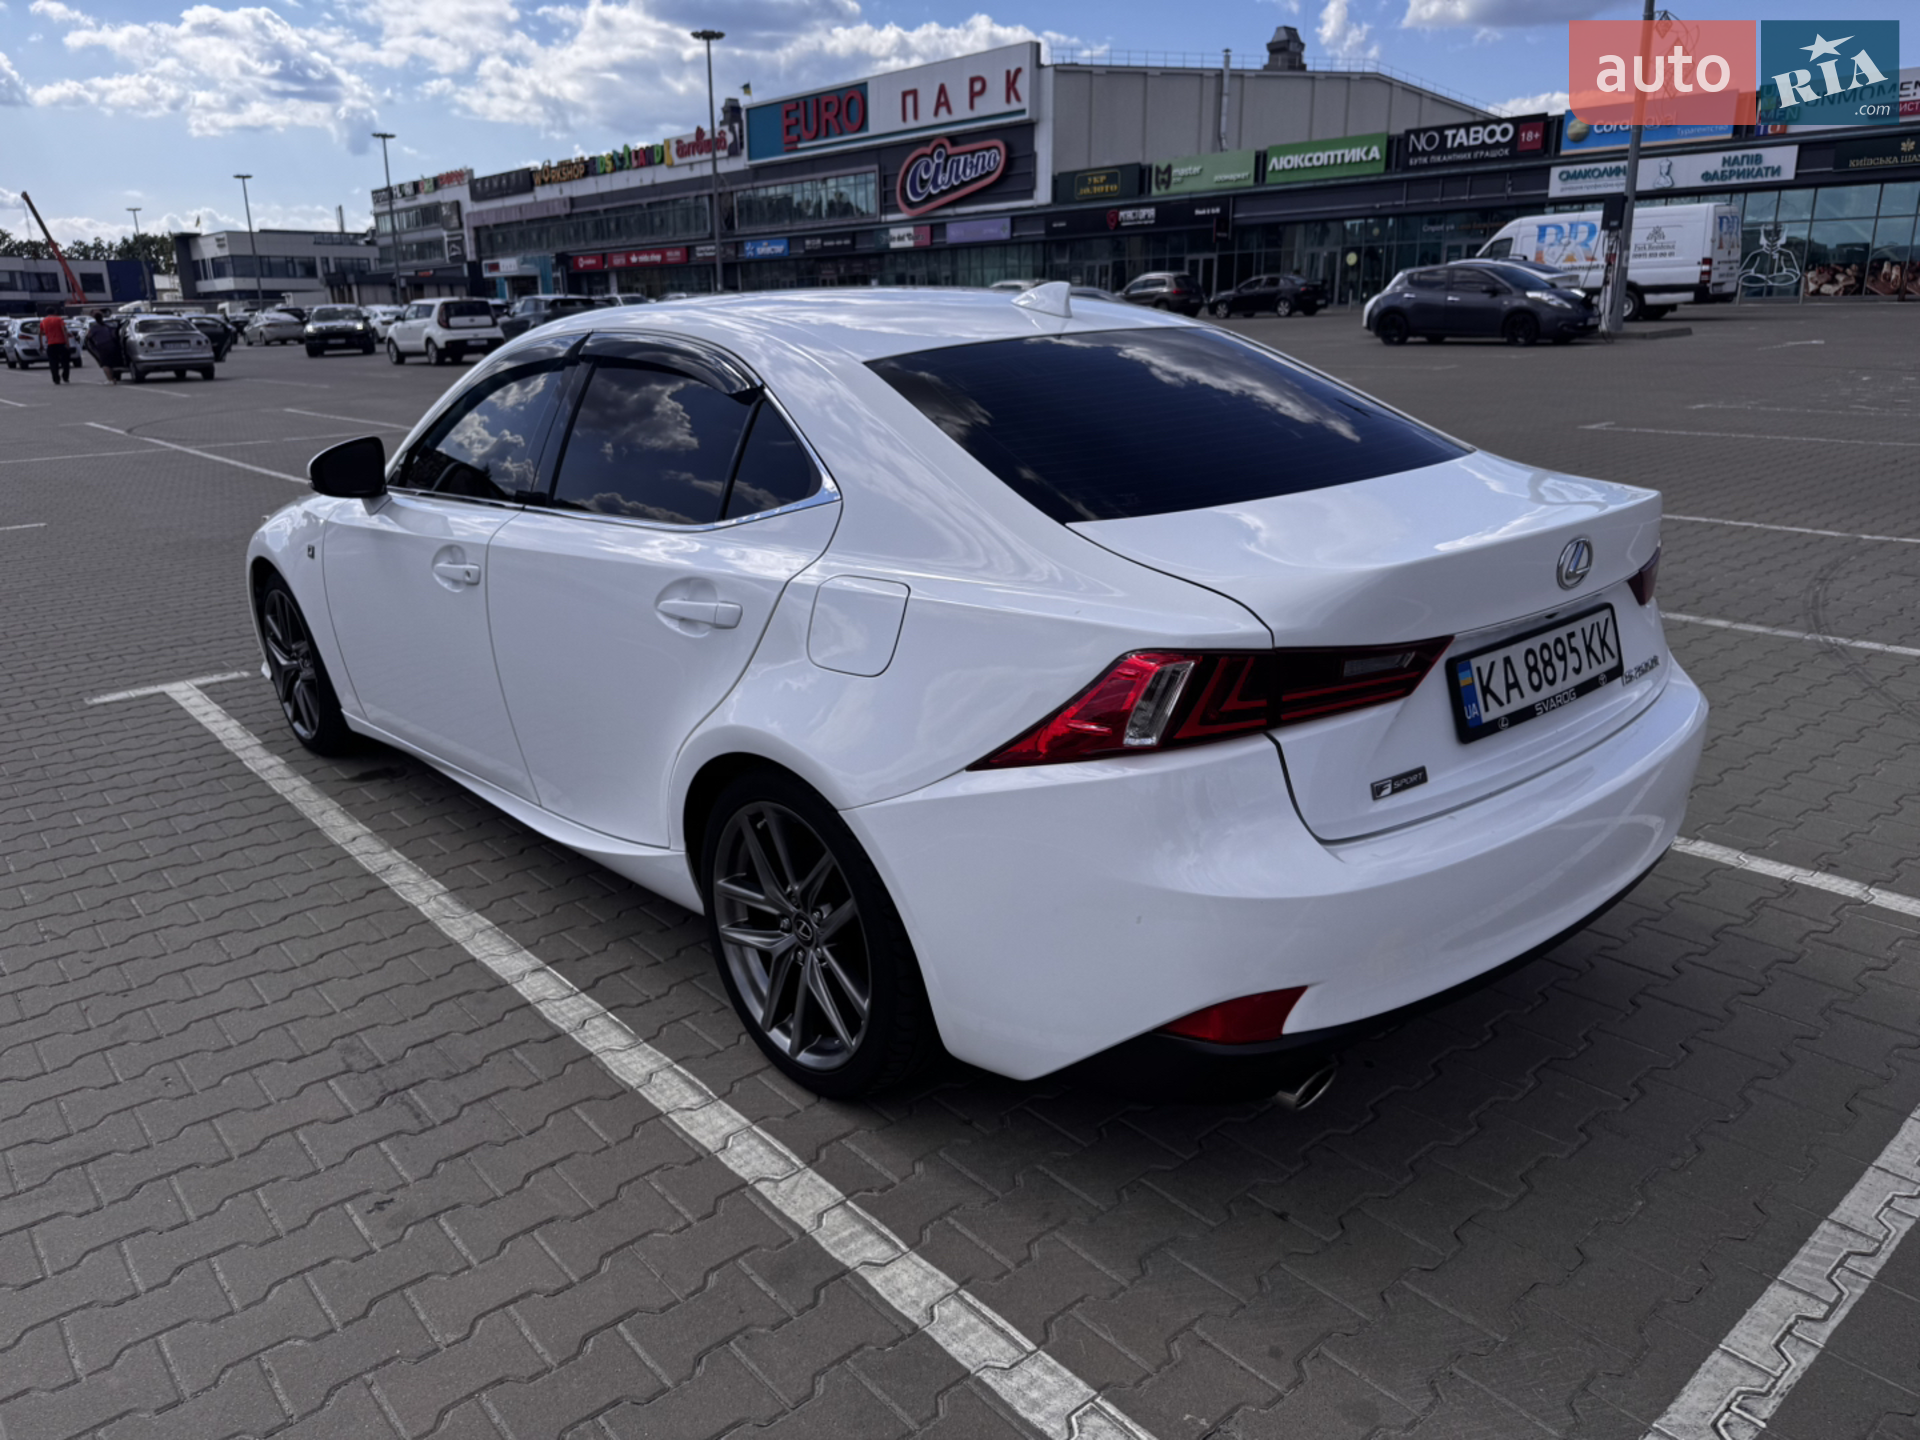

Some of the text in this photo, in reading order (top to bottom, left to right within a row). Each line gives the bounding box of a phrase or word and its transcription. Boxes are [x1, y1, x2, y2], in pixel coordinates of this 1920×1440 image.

[782, 89, 866, 146] EURO
[901, 67, 1023, 123] ПАРК
[1593, 115, 1633, 134] Coral
[1408, 123, 1514, 153] NO TABOO
[1520, 132, 1540, 142] 18+
[1268, 146, 1381, 172] ЛЮКСОПТИКА
[1408, 148, 1510, 166] БУТІК ПІКАНТНИХ ІГРАШОК
[1721, 153, 1763, 168] НАПІВ
[1848, 156, 1899, 168] КИЇВСЬКА
[533, 164, 586, 187] WORKSHOP
[906, 147, 1001, 202] Сільпо
[1172, 165, 1203, 177] master
[1701, 166, 1782, 183] ФАБРИКАТИ
[1476, 655, 1524, 713] KA
[1524, 630, 1582, 694] 8895
[1580, 616, 1616, 671] KK
[1535, 688, 1577, 716] SVAROG
[1464, 704, 1480, 720] UA
[1393, 771, 1424, 789] SPORT
